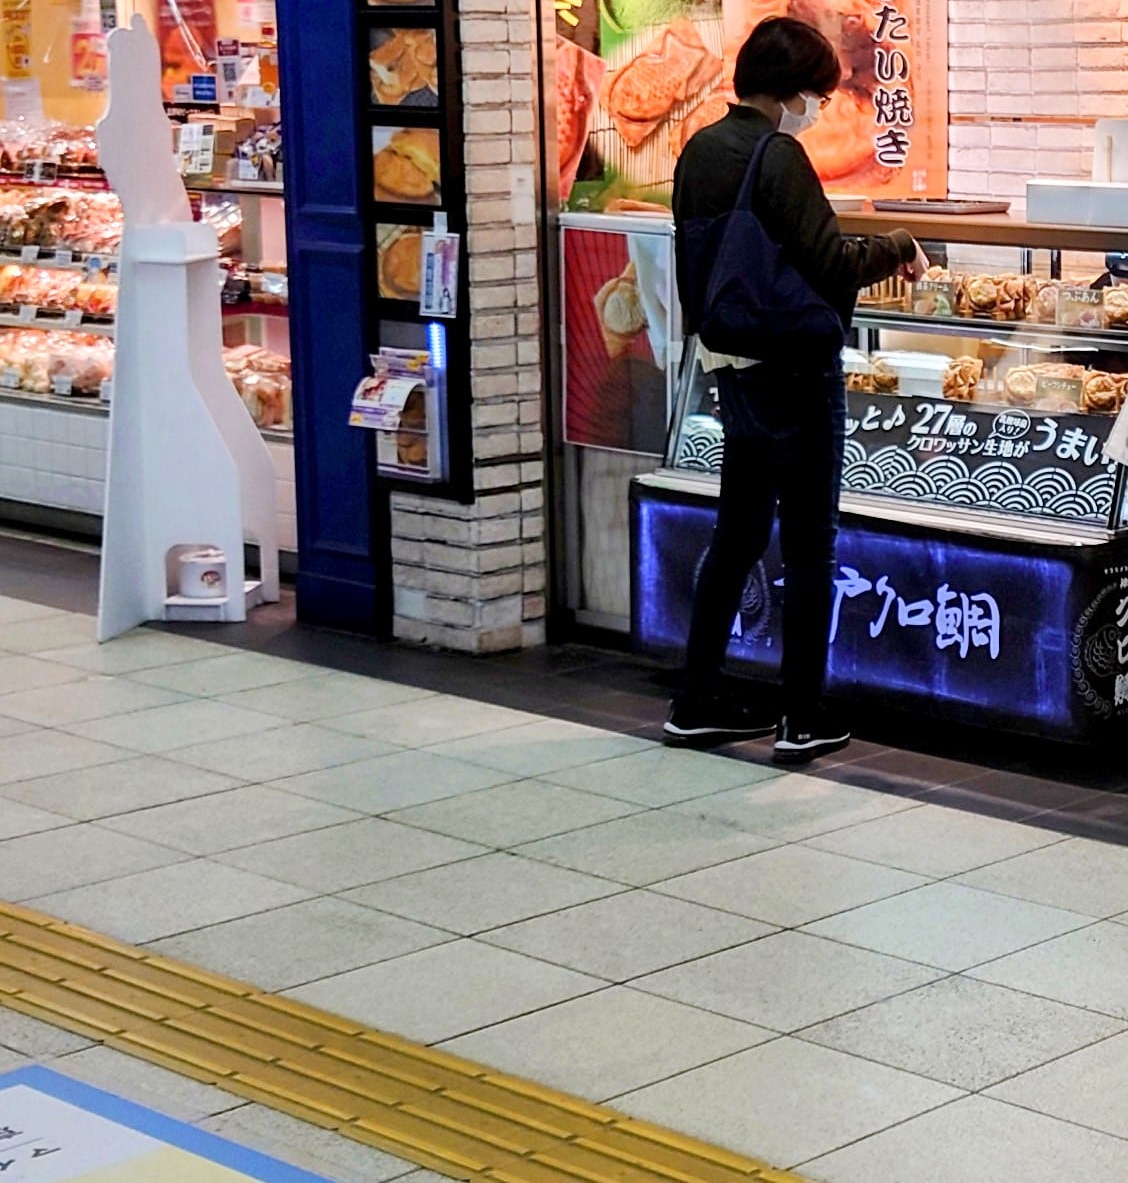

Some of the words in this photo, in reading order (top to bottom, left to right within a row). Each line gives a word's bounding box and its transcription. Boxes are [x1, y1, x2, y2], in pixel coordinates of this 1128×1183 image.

[1062, 291, 1100, 304] つぶあん
[910, 403, 977, 437] 27層の
[907, 434, 1029, 459] クロワッサン生地が
[773, 567, 1000, 659] 戸クロ鯛
